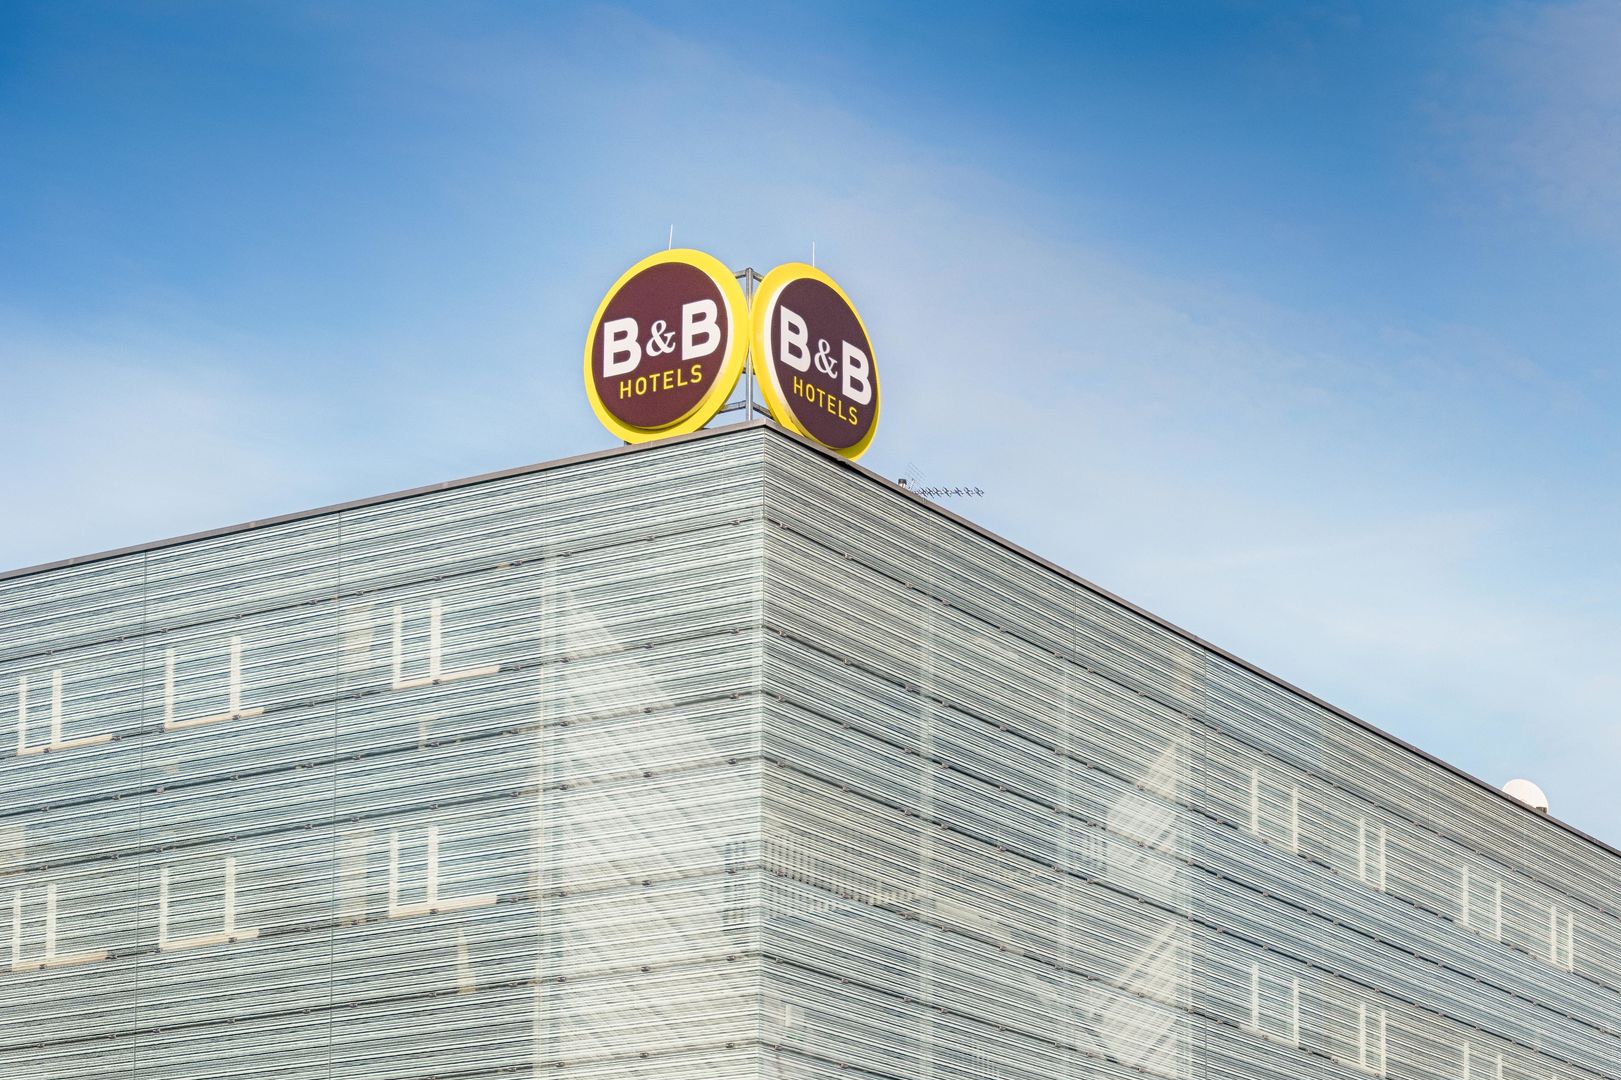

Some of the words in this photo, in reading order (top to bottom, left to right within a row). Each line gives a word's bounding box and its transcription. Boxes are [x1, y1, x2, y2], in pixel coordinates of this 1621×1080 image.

[603, 298, 722, 378] B&B
[780, 304, 872, 406] B&B
[619, 364, 703, 400] HOTELS
[792, 375, 858, 426] HOTELS
